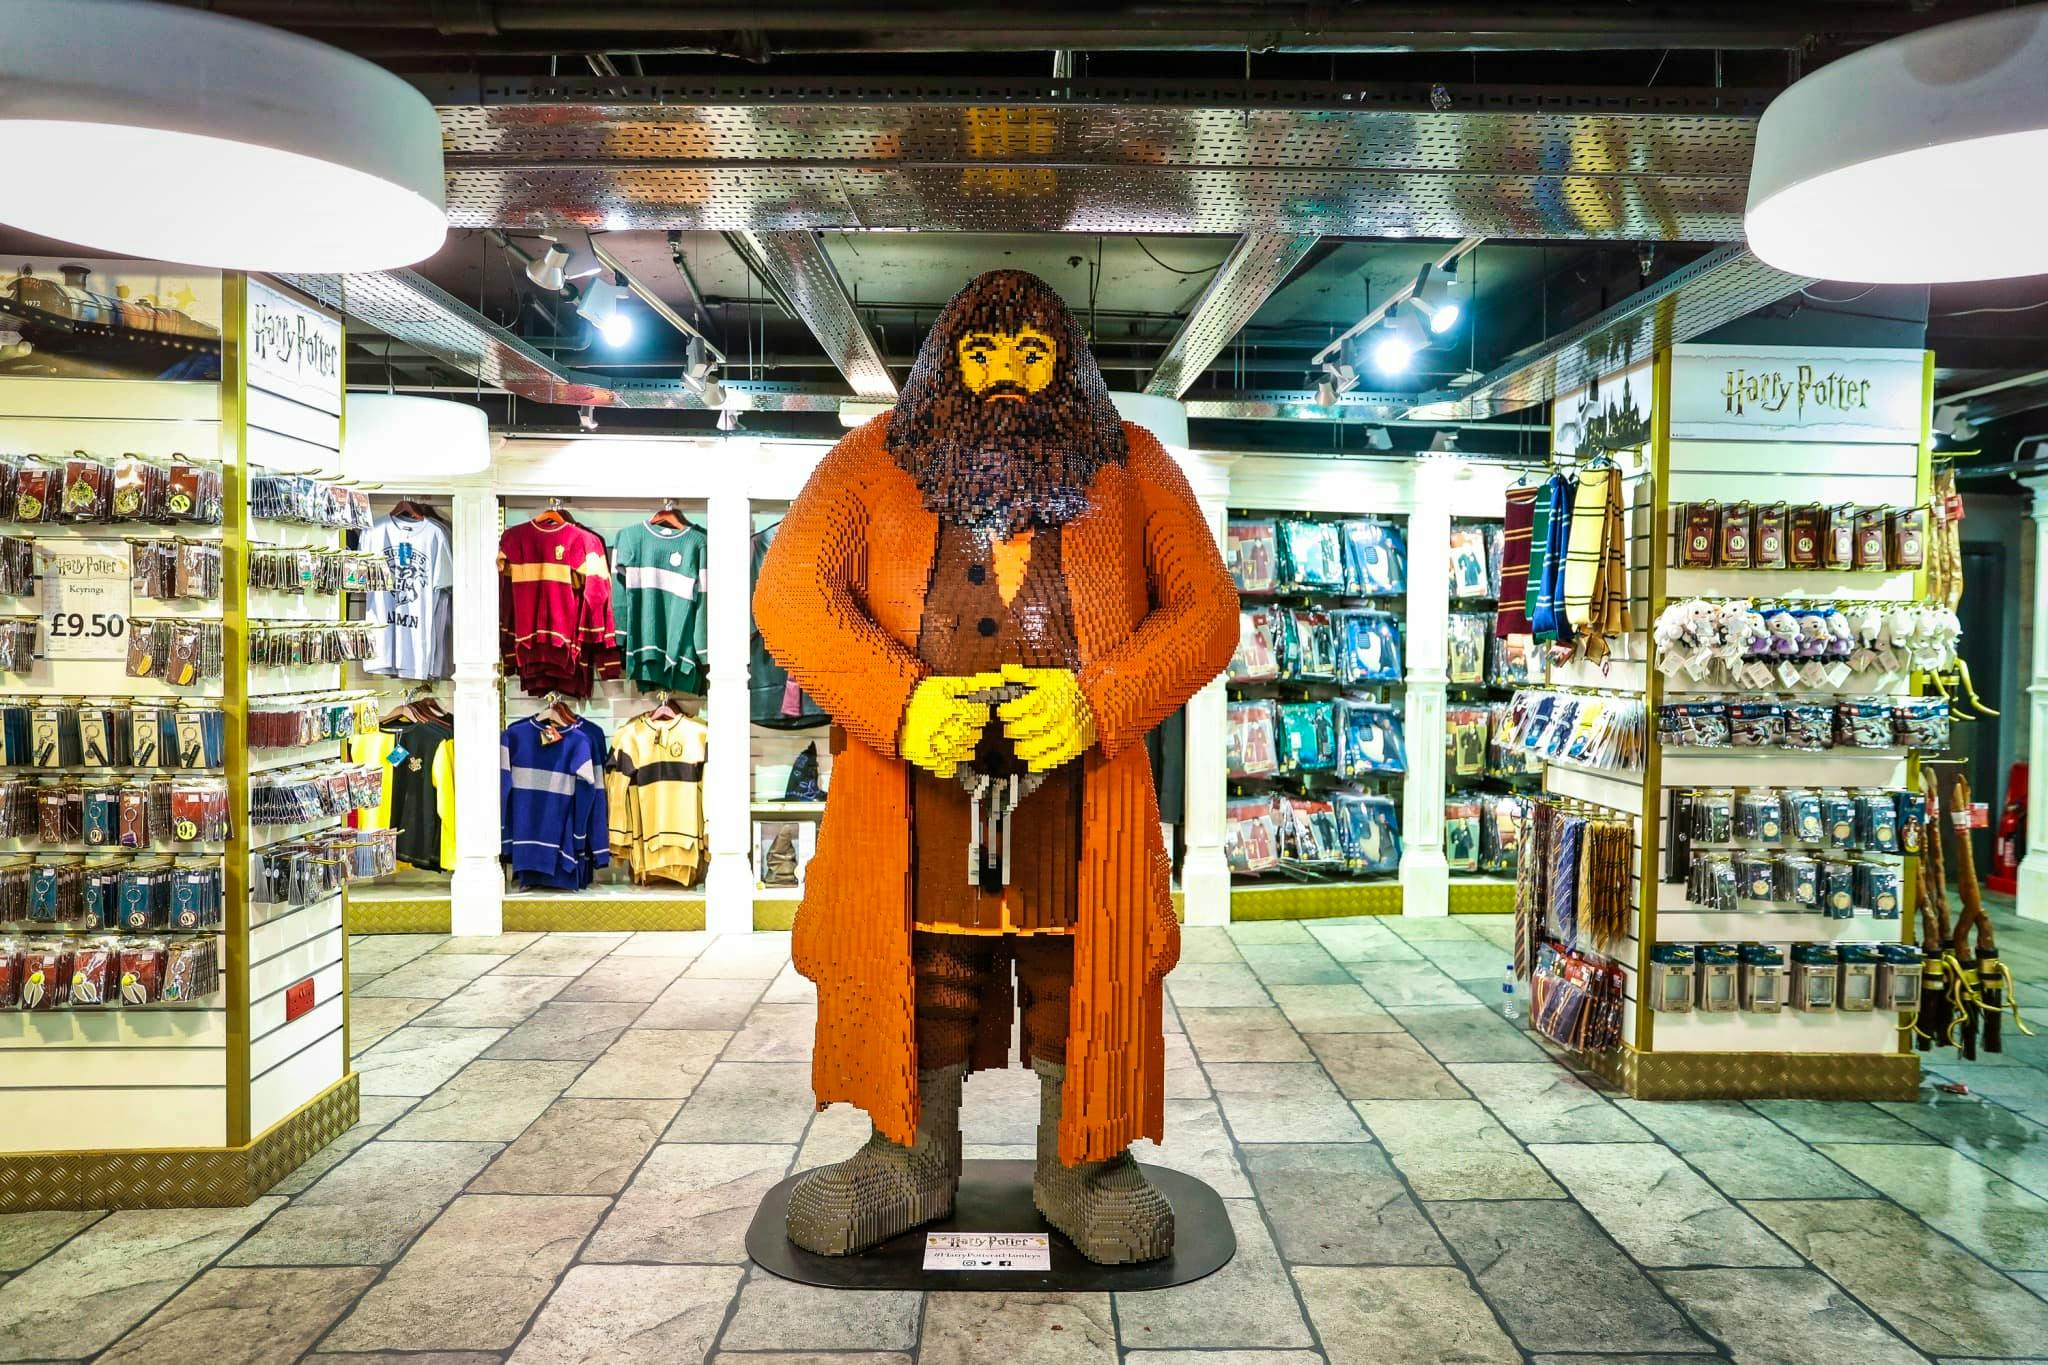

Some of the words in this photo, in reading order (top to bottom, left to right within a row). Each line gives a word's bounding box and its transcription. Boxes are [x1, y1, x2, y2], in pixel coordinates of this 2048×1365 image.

[253, 304, 296, 363] Harry
[297, 314, 337, 378] Potter
[1721, 369, 1793, 417] Harry
[1797, 365, 1872, 422] Potter
[56, 558, 86, 577] Harry
[86, 556, 117, 577] Potter
[69, 584, 105, 596] Keyrings
[50, 613, 125, 638] £9.50
[949, 1236, 988, 1248] Harry
[988, 1236, 1029, 1249] Potter
